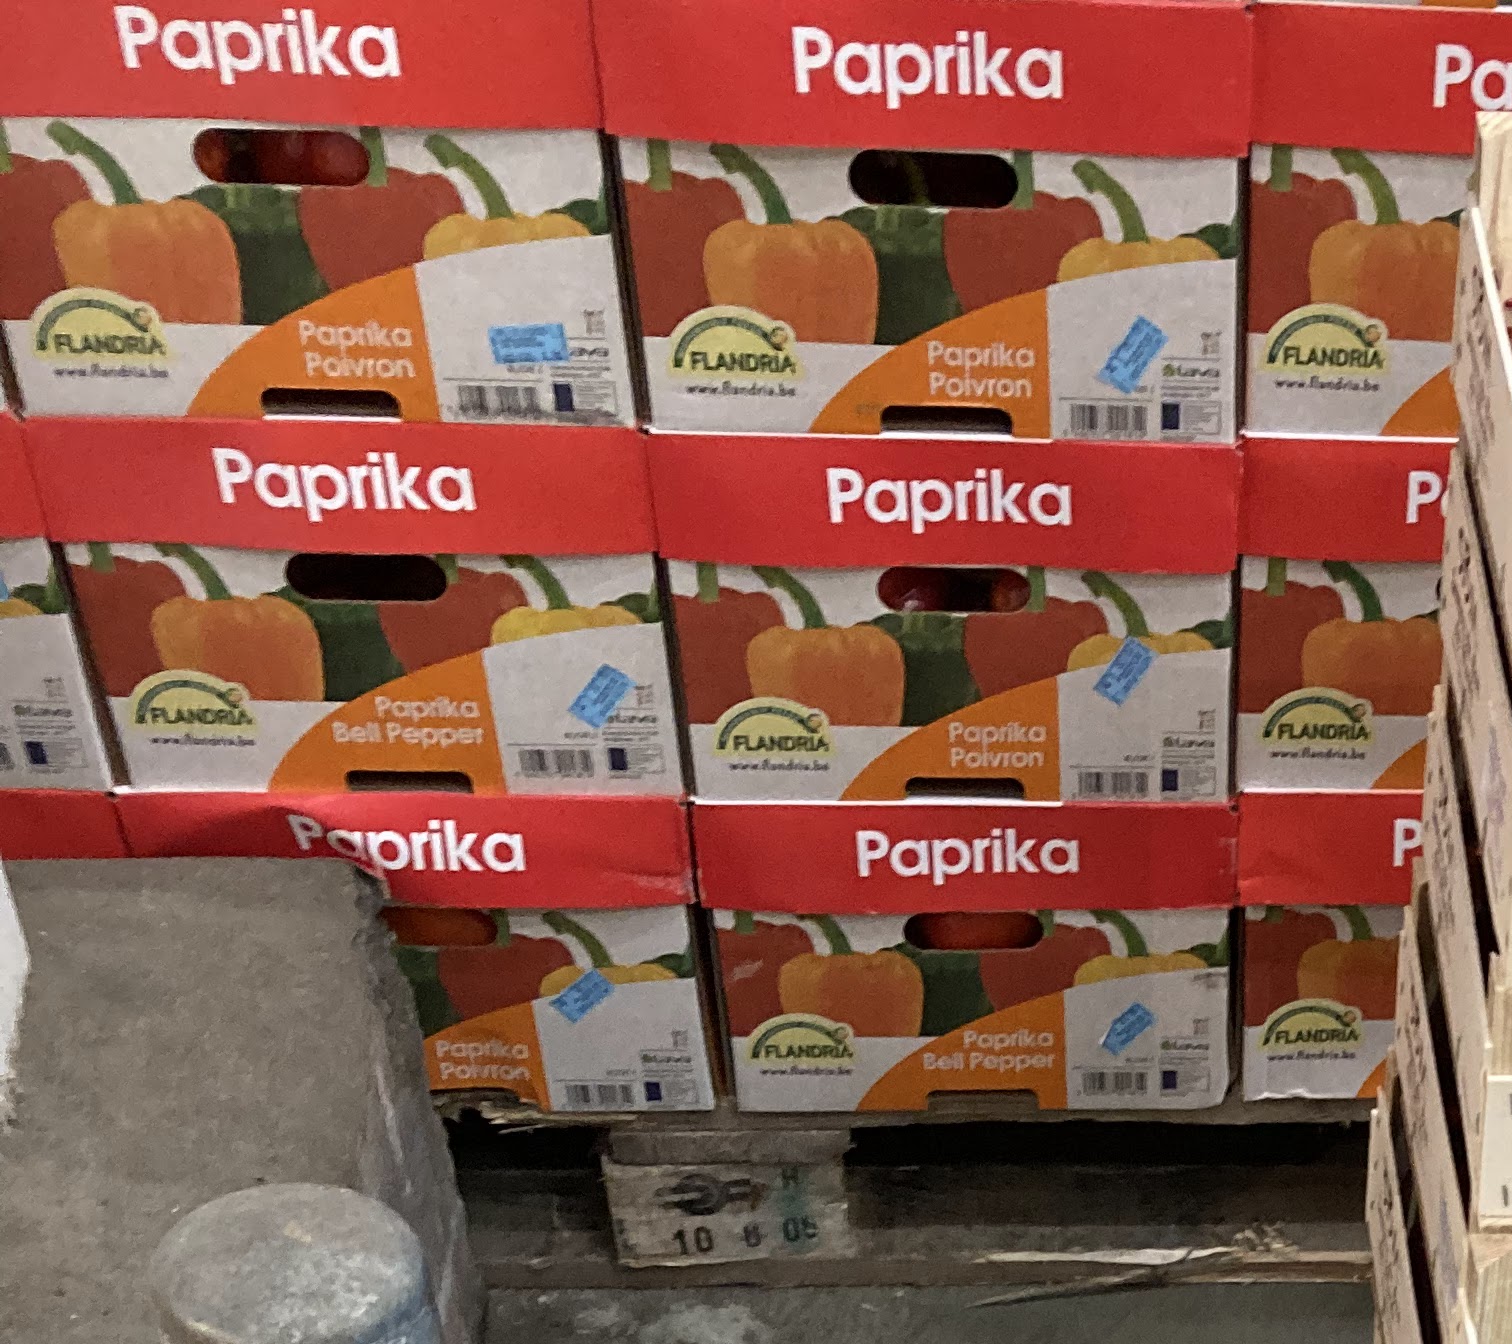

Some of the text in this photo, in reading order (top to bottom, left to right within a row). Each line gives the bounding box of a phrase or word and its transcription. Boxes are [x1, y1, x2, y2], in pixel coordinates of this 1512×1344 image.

[114, 6, 401, 85] Paprika
[792, 26, 1063, 108] Paprika
[55, 333, 166, 355] FLANDRIA
[299, 320, 412, 350] Paprika
[306, 352, 414, 378] Poivron
[691, 351, 795, 375] FLANDRIA
[928, 340, 1034, 372] Paprika
[1284, 347, 1384, 368] FLANDRIA
[930, 372, 1031, 398] Poivron
[1275, 376, 1379, 392] www.flandria.be
[212, 448, 477, 521] Paprika
[826, 467, 1072, 533] Paprika
[150, 709, 253, 725] FLANDRIA
[375, 696, 480, 721] Paprika
[333, 722, 484, 747] Bell Pepper
[734, 734, 829, 753] FLANDRIA
[949, 721, 1046, 750] Paprika
[1276, 723, 1368, 742] FLANDRIA
[949, 747, 1043, 768] Poivron
[288, 815, 525, 871] Paprika
[856, 829, 1079, 886] Paprika
[963, 1030, 1053, 1051] Paprika
[1275, 1027, 1359, 1044] FLANDRIA
[435, 1041, 528, 1061] Paprika
[764, 1044, 853, 1060] FLANDRIA
[923, 1050, 1054, 1073] Bell Pepper
[440, 1062, 528, 1080] Poivron
